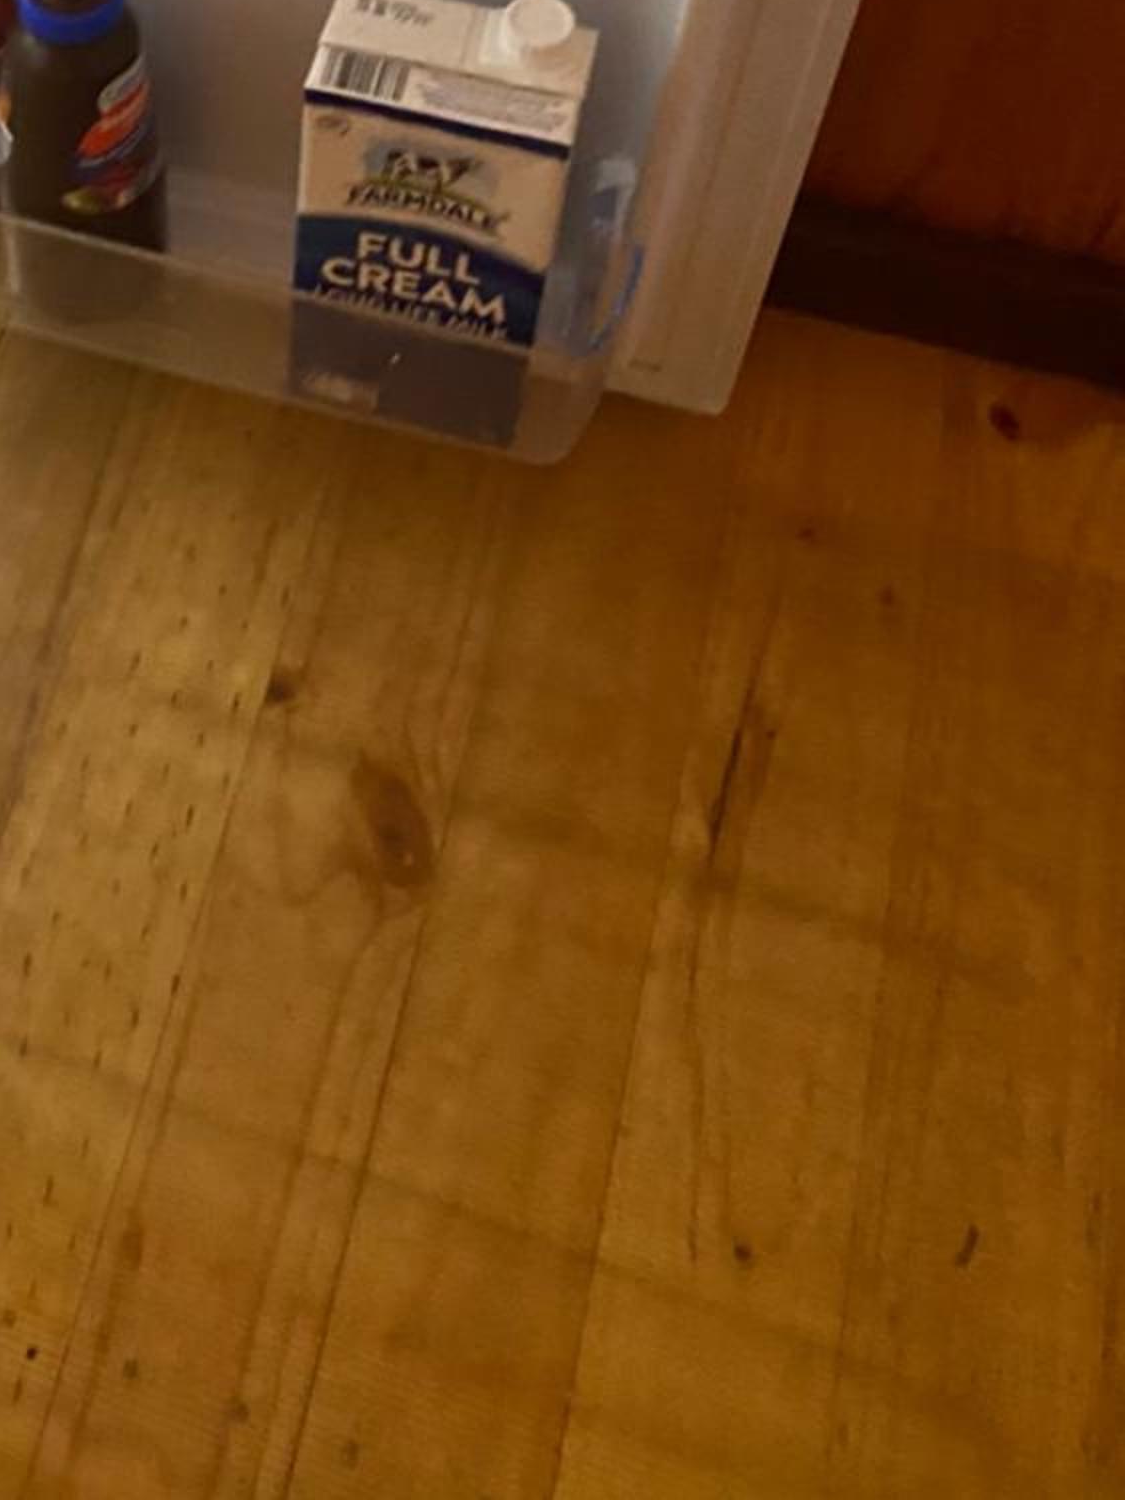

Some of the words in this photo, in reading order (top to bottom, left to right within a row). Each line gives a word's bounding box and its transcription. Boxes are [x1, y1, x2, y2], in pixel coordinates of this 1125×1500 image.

[347, 183, 500, 232] FARMDALE
[357, 230, 481, 285] FULL
[321, 257, 508, 324] CREAM
